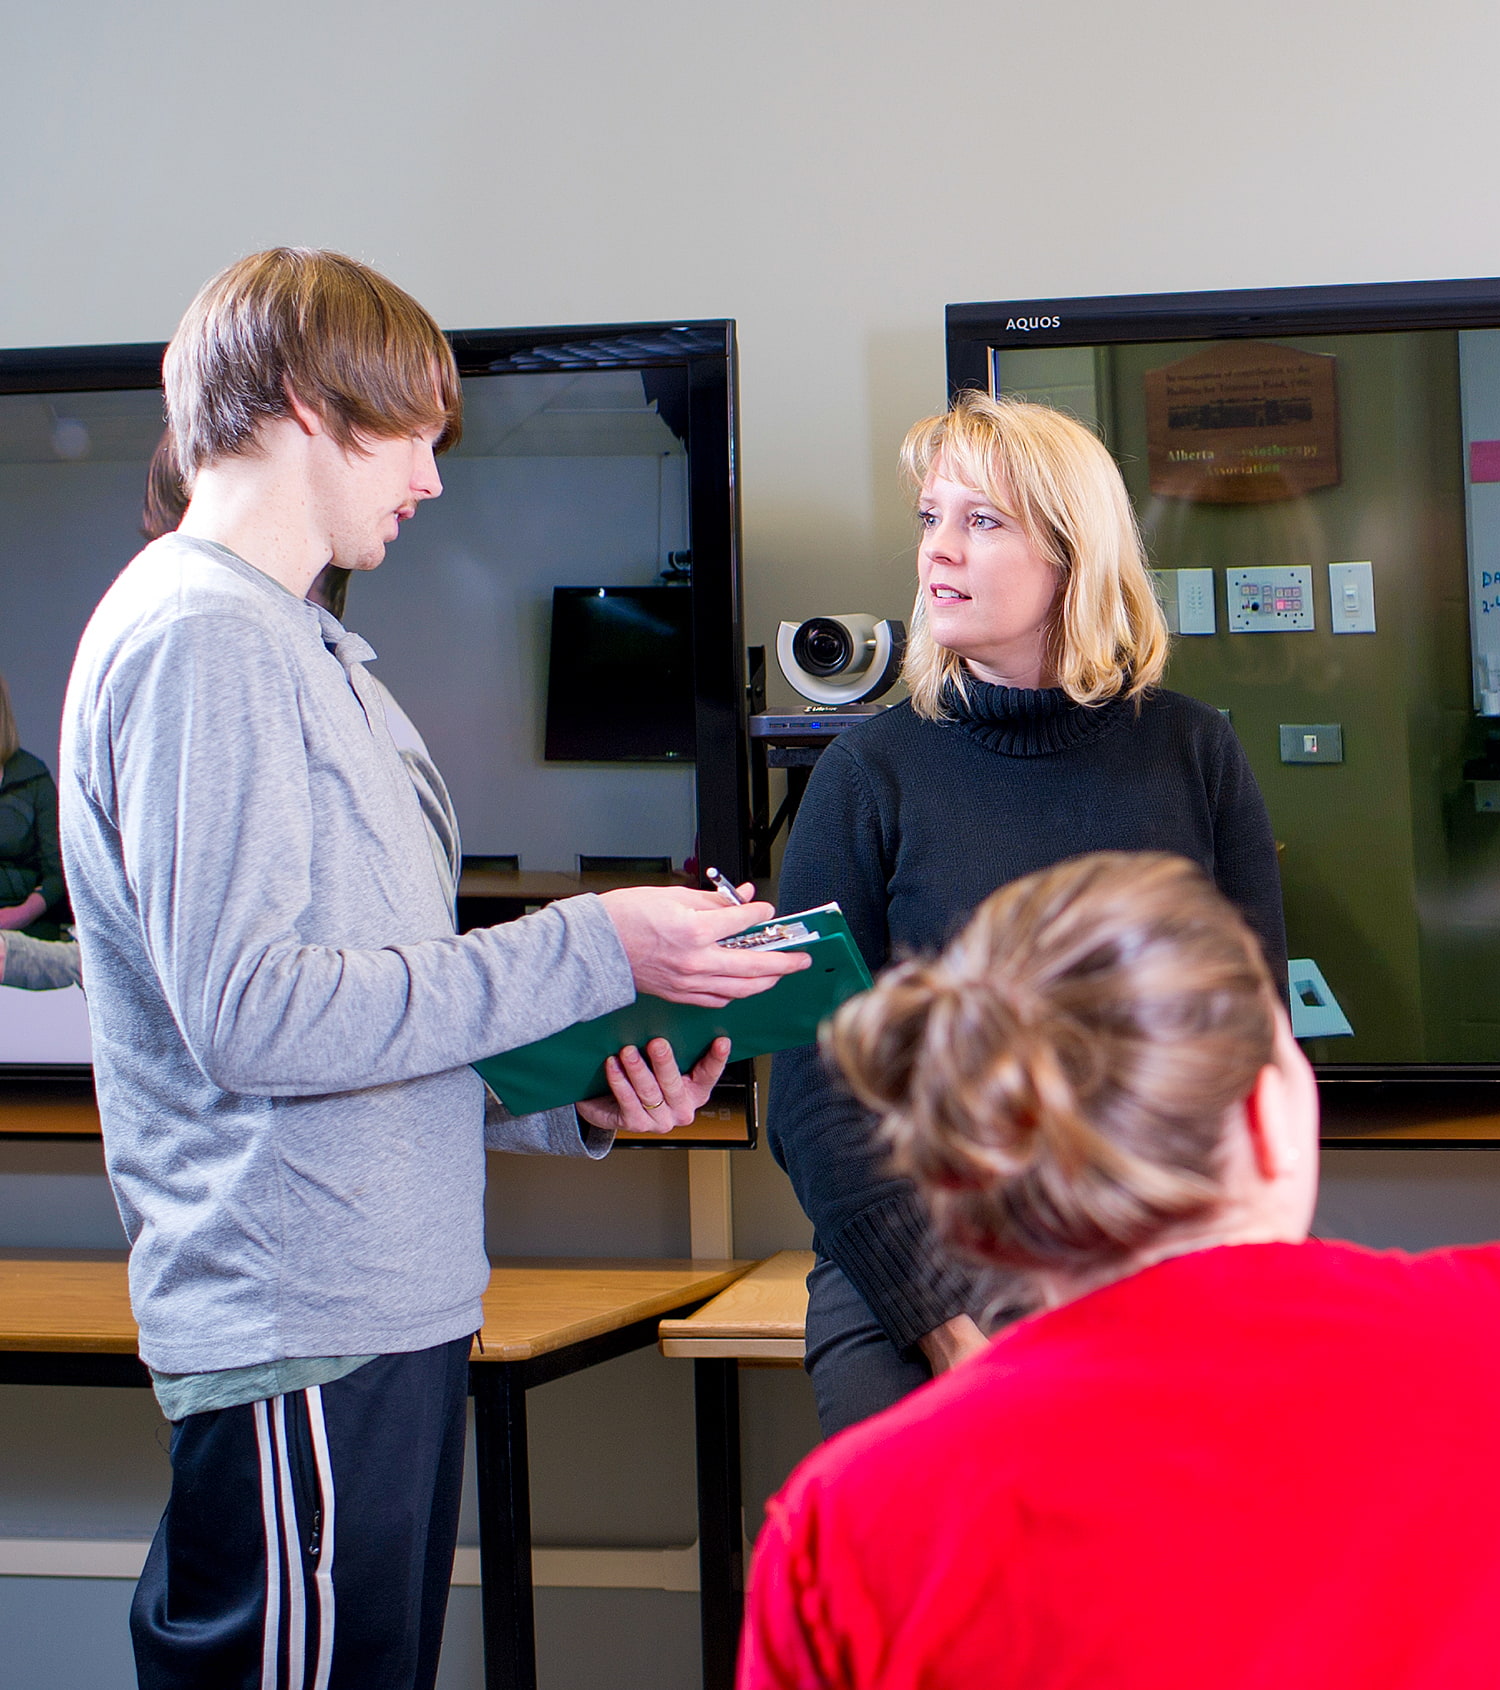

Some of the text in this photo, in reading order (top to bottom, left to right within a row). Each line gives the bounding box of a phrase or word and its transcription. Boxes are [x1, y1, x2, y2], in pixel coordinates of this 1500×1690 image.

[1005, 316, 1061, 331] AQUOS
[1167, 444, 1318, 462] Alberta ysiotherapy
[1205, 463, 1280, 476] Association
